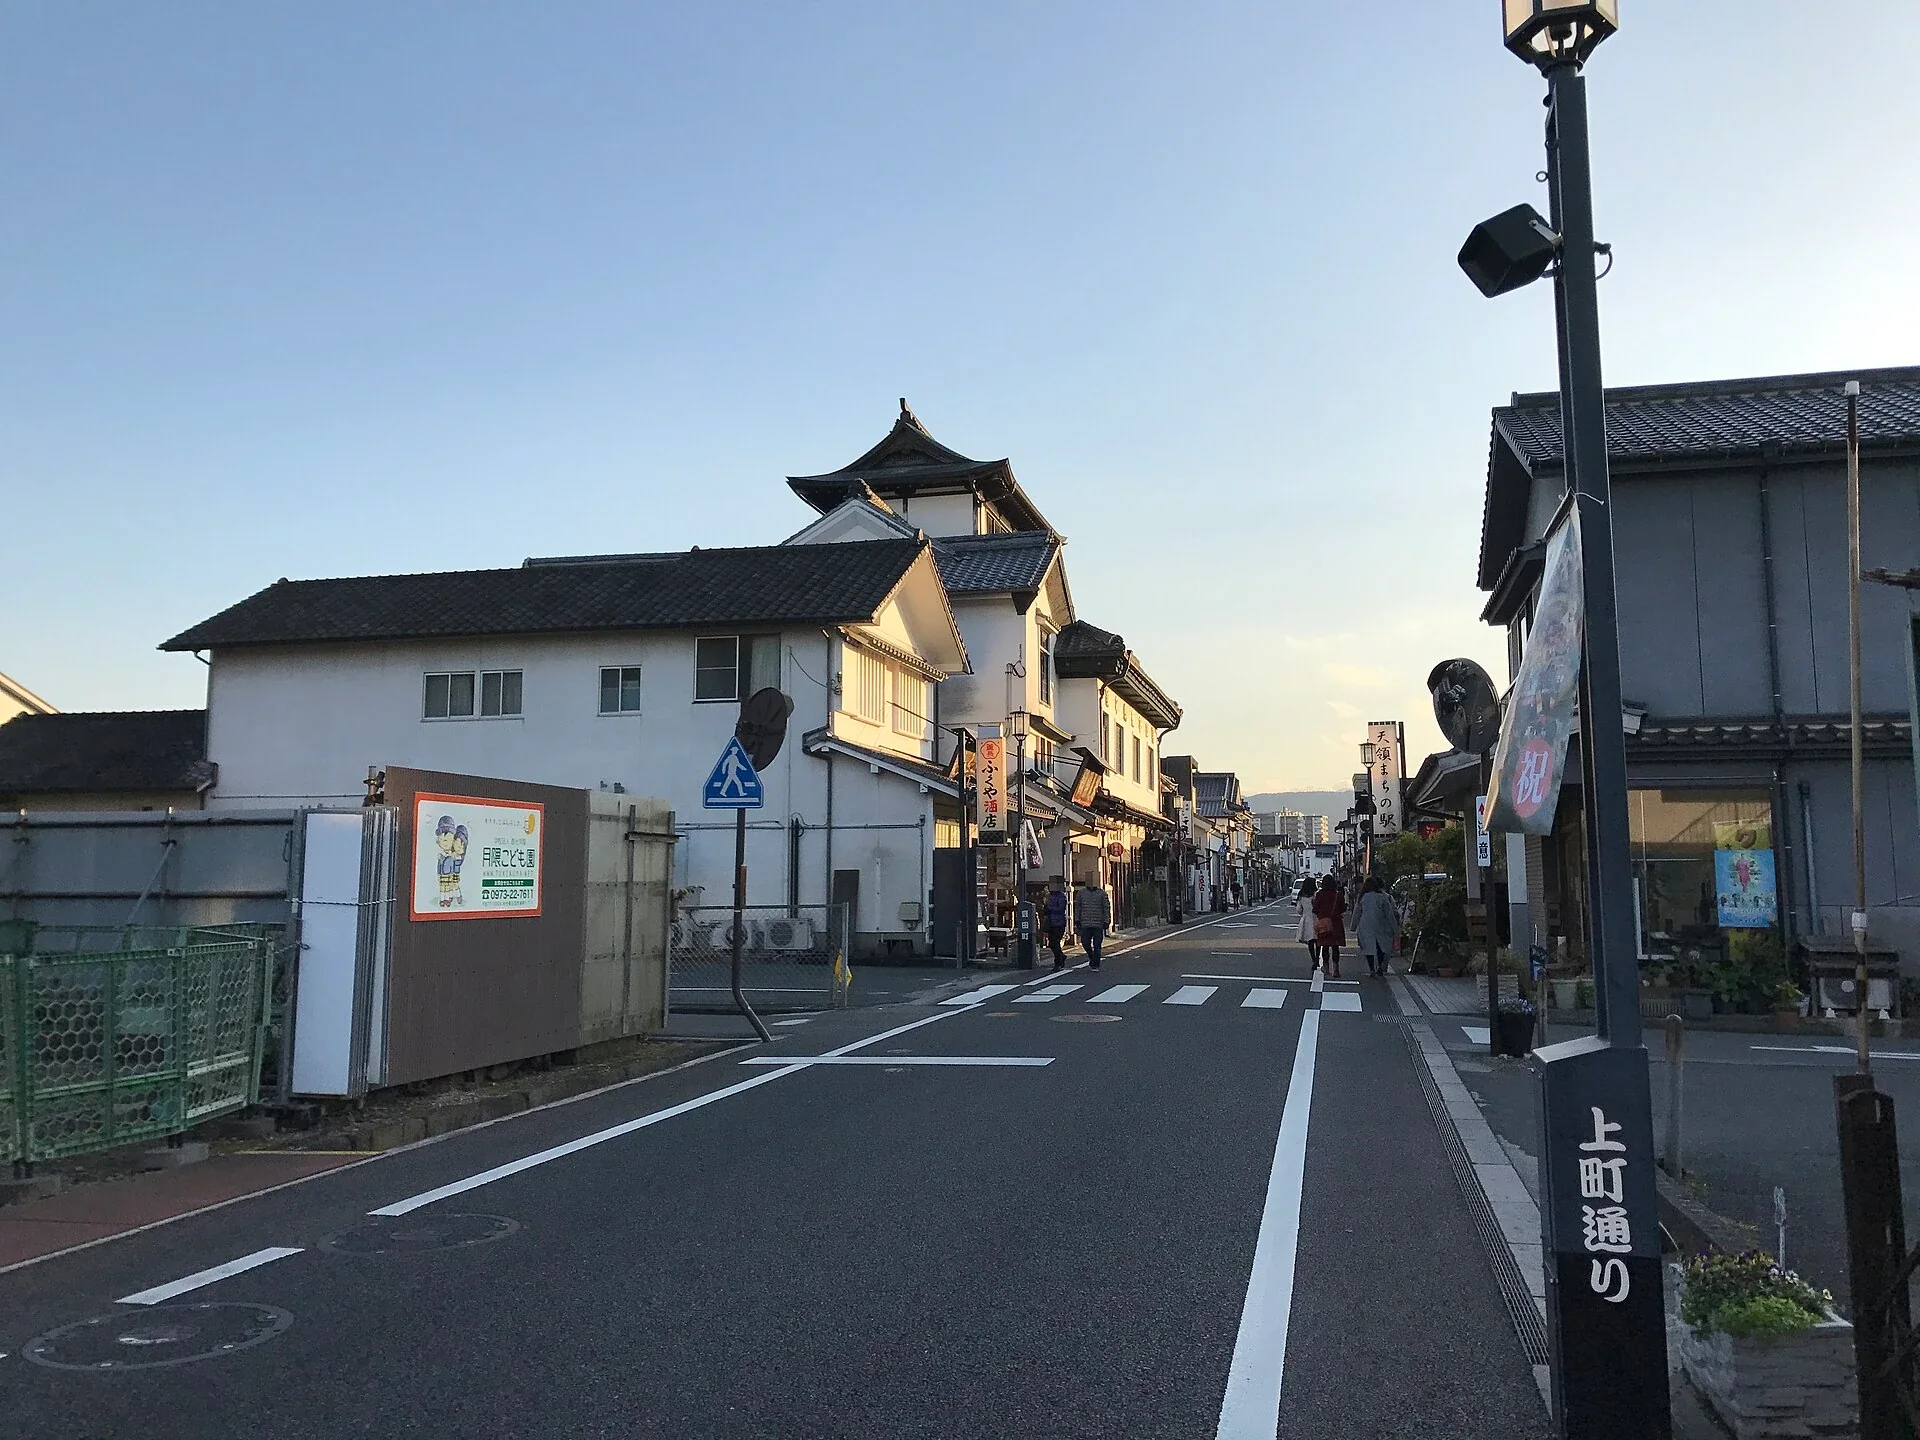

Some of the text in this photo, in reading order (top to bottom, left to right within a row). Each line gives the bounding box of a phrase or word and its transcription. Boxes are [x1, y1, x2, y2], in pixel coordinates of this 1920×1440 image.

[981, 760, 999, 828] ふくや酒店
[1375, 730, 1397, 831] 天領まちの駅
[1516, 749, 1549, 805] 祝
[482, 847, 535, 868] 月隈こども園
[490, 888, 534, 900] 0973-22-7611
[1578, 1106, 1633, 1303] 上町通り
